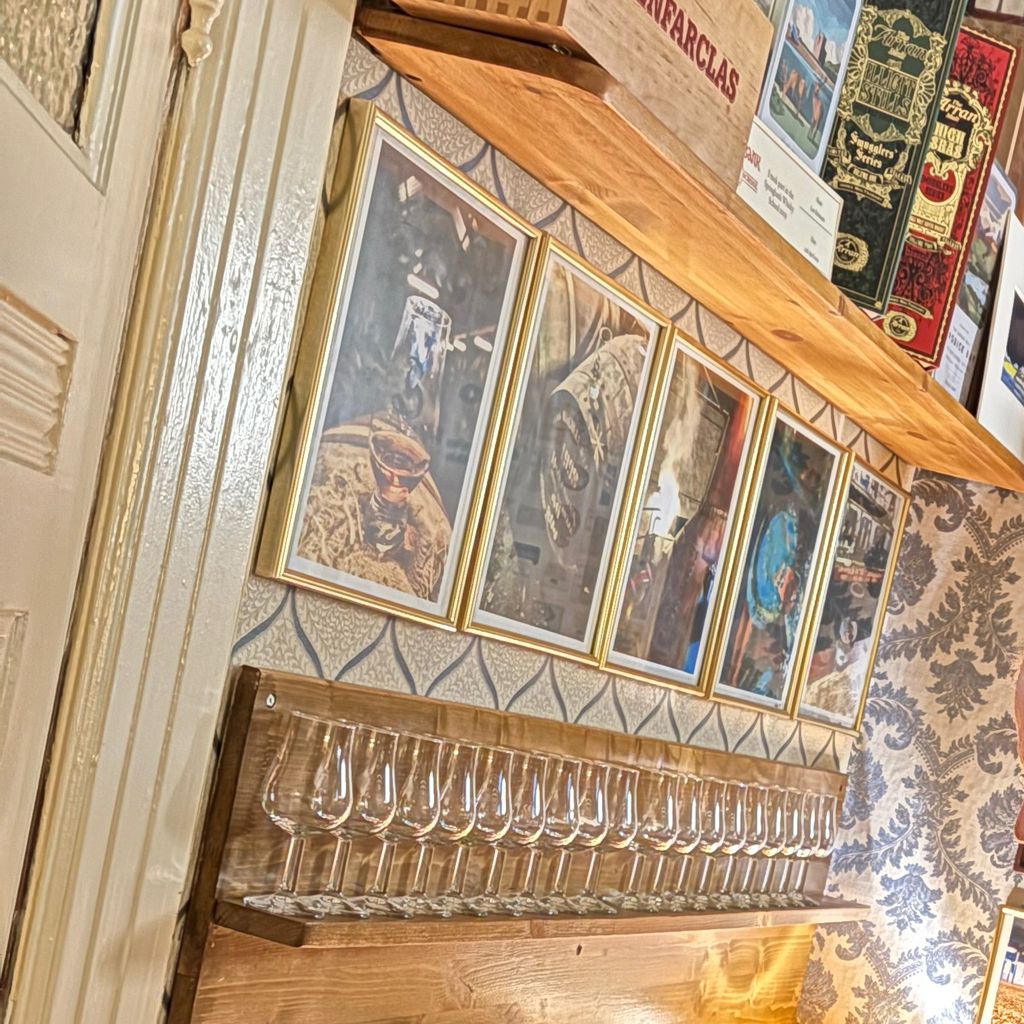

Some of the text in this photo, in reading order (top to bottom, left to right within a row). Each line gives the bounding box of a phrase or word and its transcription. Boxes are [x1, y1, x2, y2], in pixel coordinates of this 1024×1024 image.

[634, 0, 741, 104] NFARCLAS
[940, 97, 979, 123] Arran
[935, 122, 967, 144] HIGH
[855, 148, 883, 168] Series
[930, 136, 962, 159] SEAS
